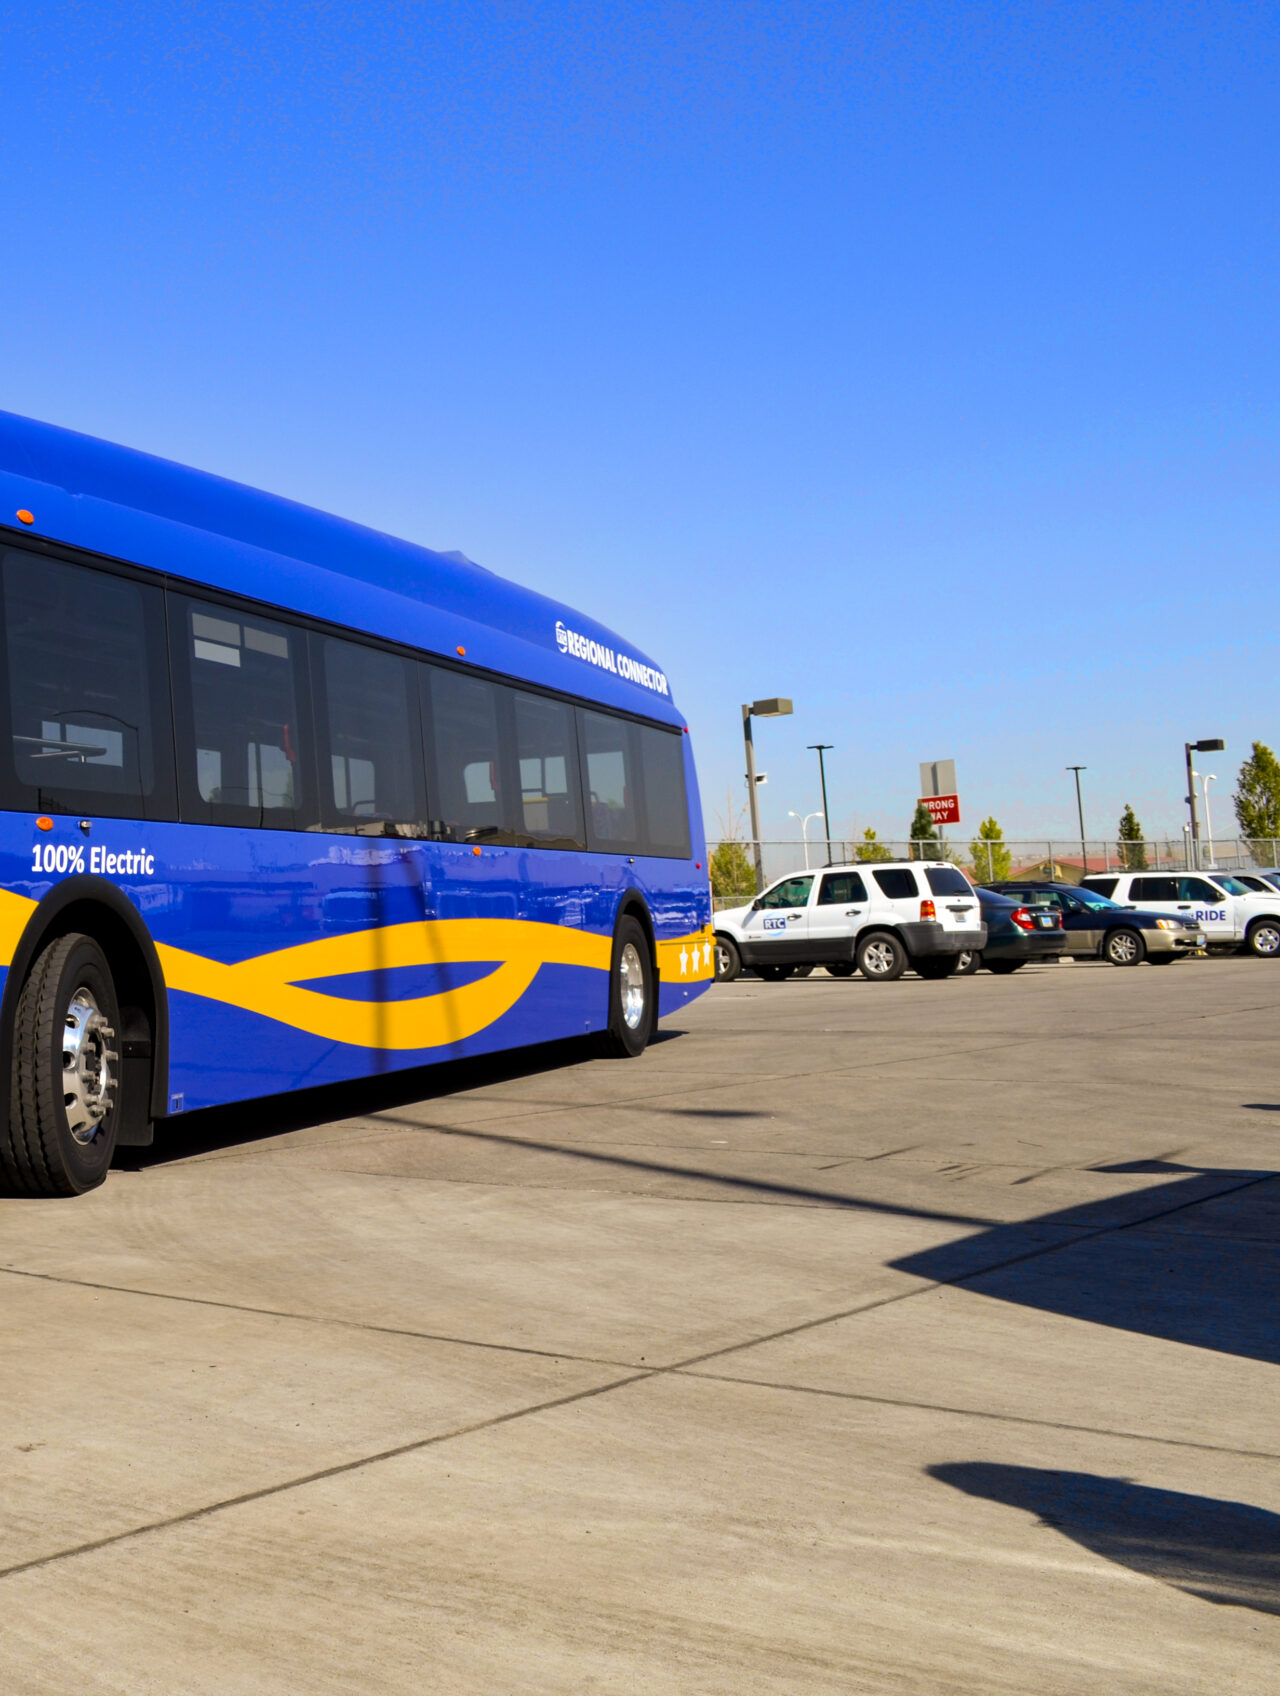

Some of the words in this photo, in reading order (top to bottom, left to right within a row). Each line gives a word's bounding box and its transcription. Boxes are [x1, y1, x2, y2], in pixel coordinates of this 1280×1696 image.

[566, 629, 617, 674] REGIONAL
[617, 653, 669, 696] CONNECTOR
[31, 844, 85, 873] 100%
[90, 845, 155, 875] Electric
[765, 919, 785, 929] RTC
[1195, 910, 1226, 921] RIDE
